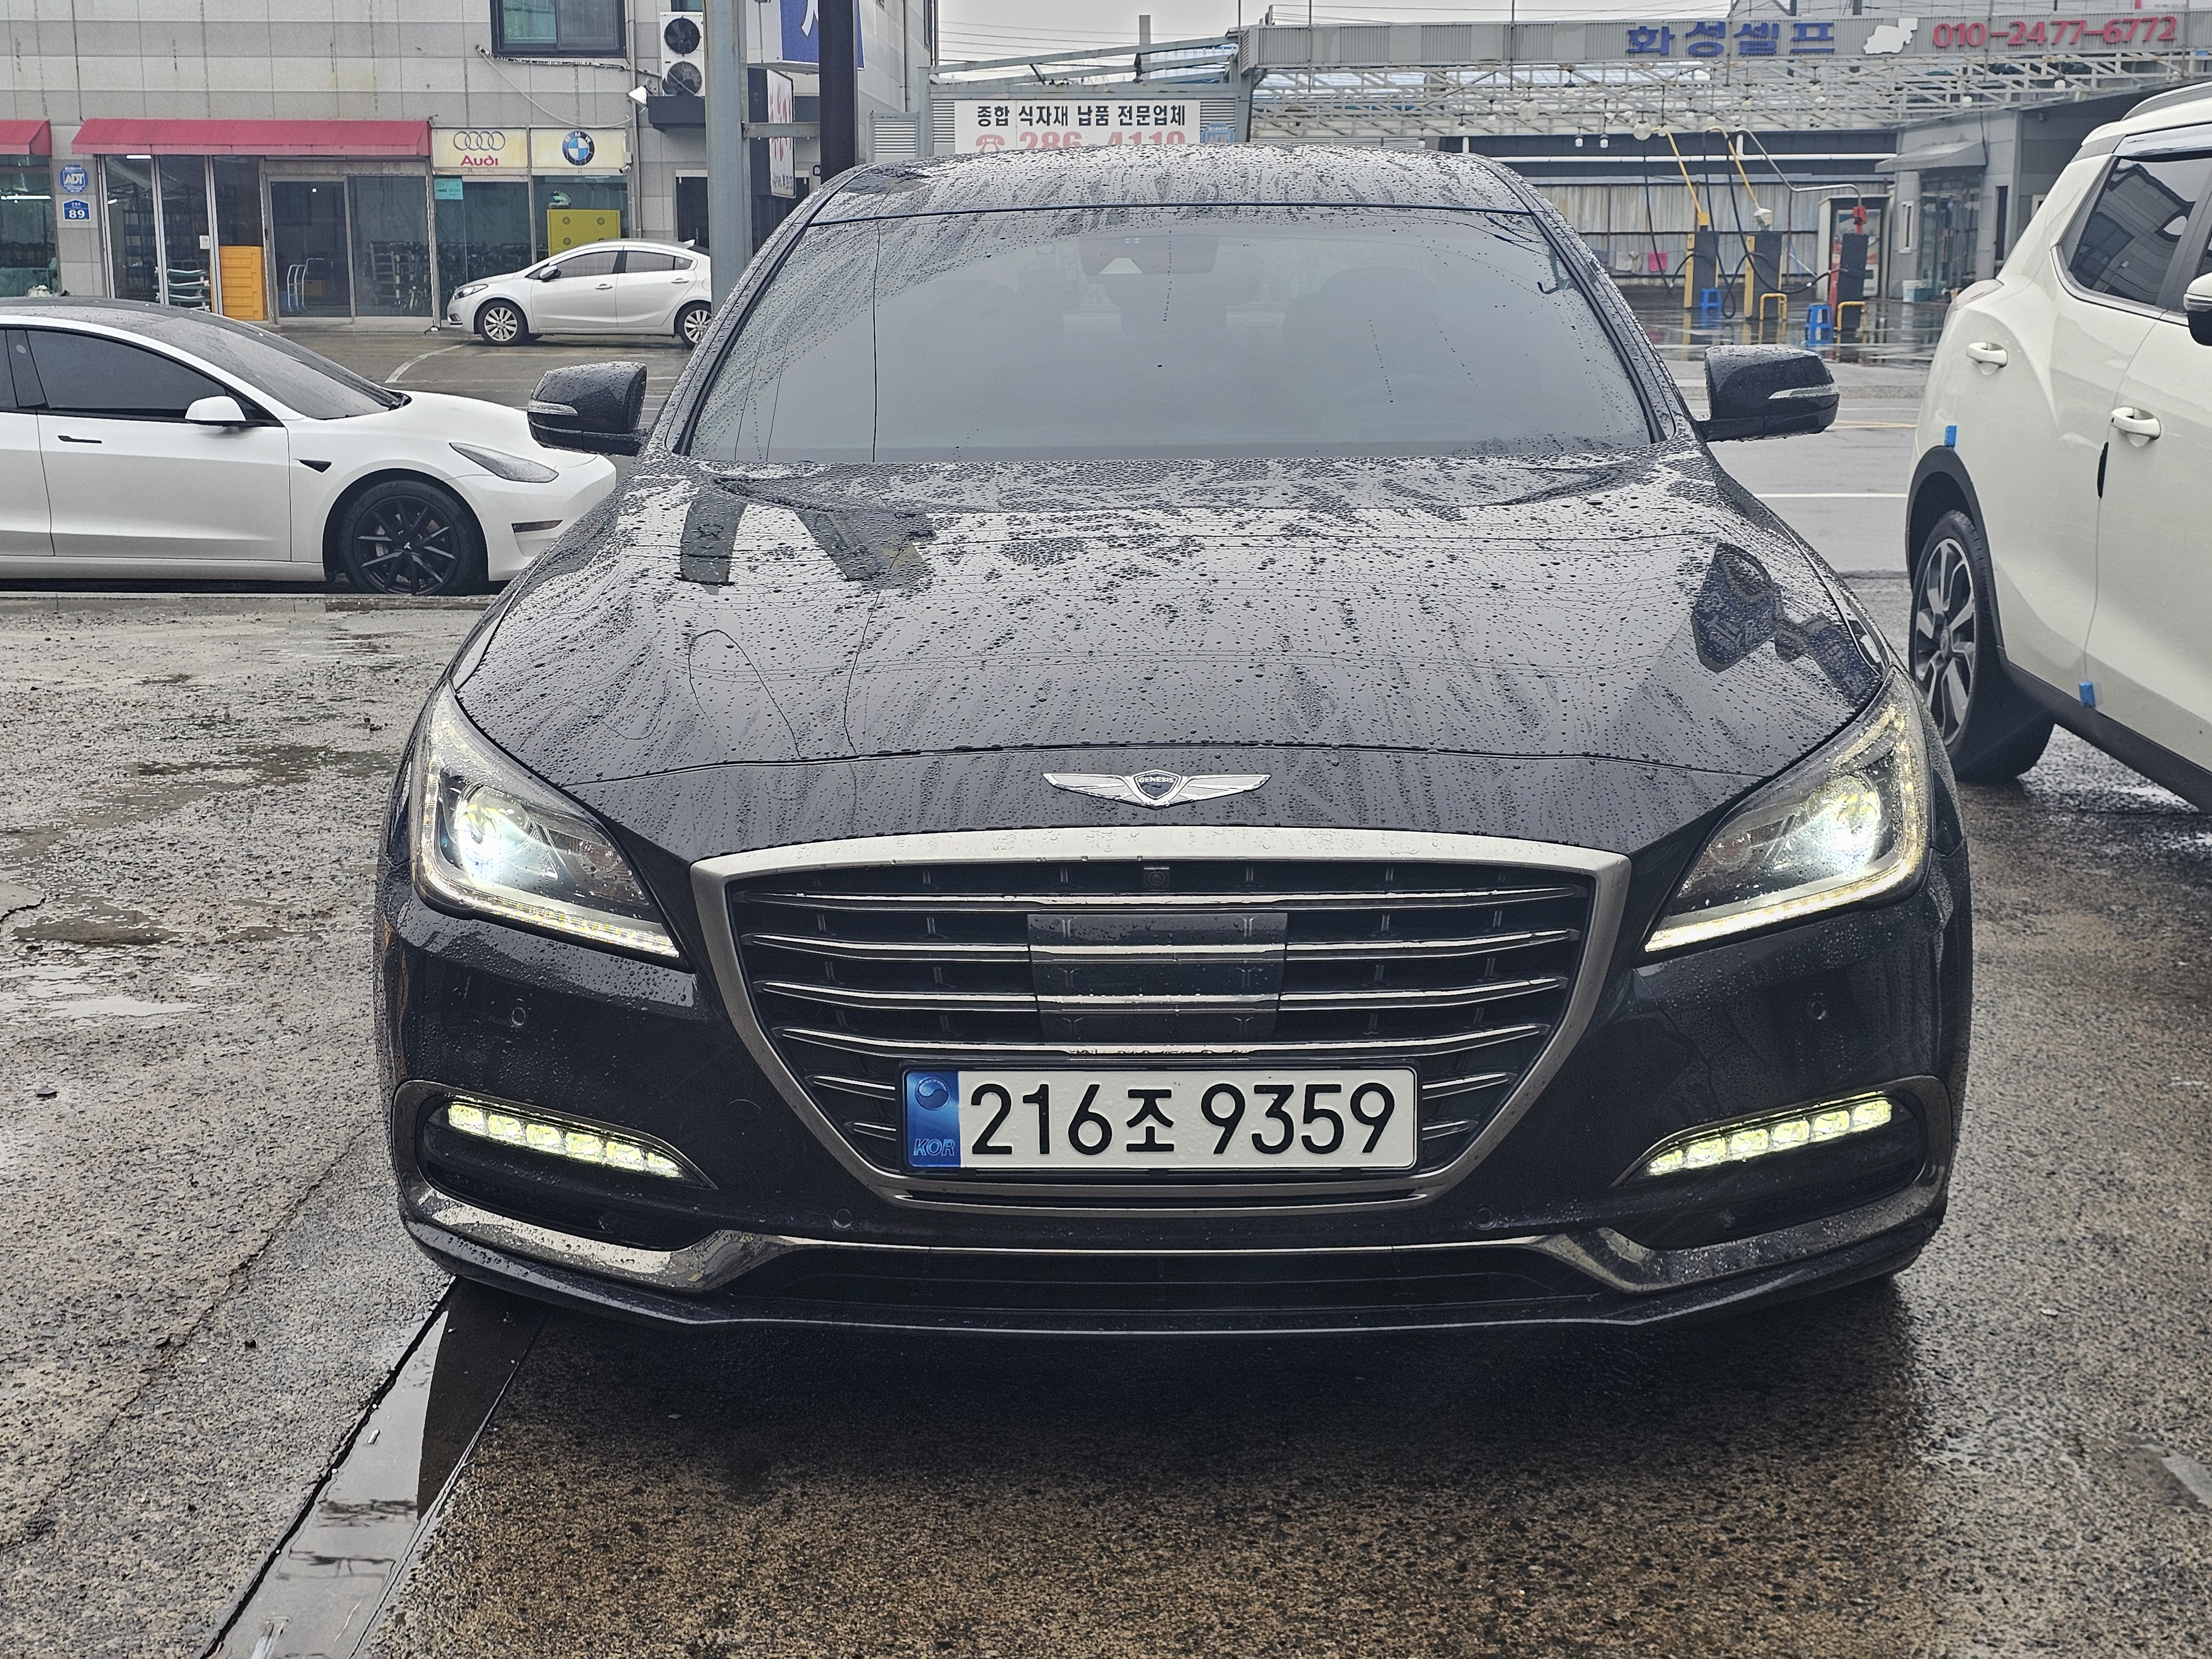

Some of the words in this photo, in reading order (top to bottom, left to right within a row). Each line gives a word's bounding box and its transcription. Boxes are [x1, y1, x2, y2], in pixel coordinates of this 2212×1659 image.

[1627, 21, 1835, 55] 화성셀프
[1933, 15, 2178, 48] 010-2477-6772
[977, 105, 1010, 127] 종합
[1018, 105, 1068, 127] 식자재
[1077, 105, 1109, 127] 납품
[1118, 105, 1186, 126] 전문업체
[565, 131, 592, 143] BMW
[460, 154, 499, 166] Audi
[64, 173, 84, 185] ADT
[69, 210, 85, 218] 89
[970, 1083, 1175, 1156] 216조
[1200, 1082, 1396, 1156] 9359
[913, 1138, 956, 1156] KOR
